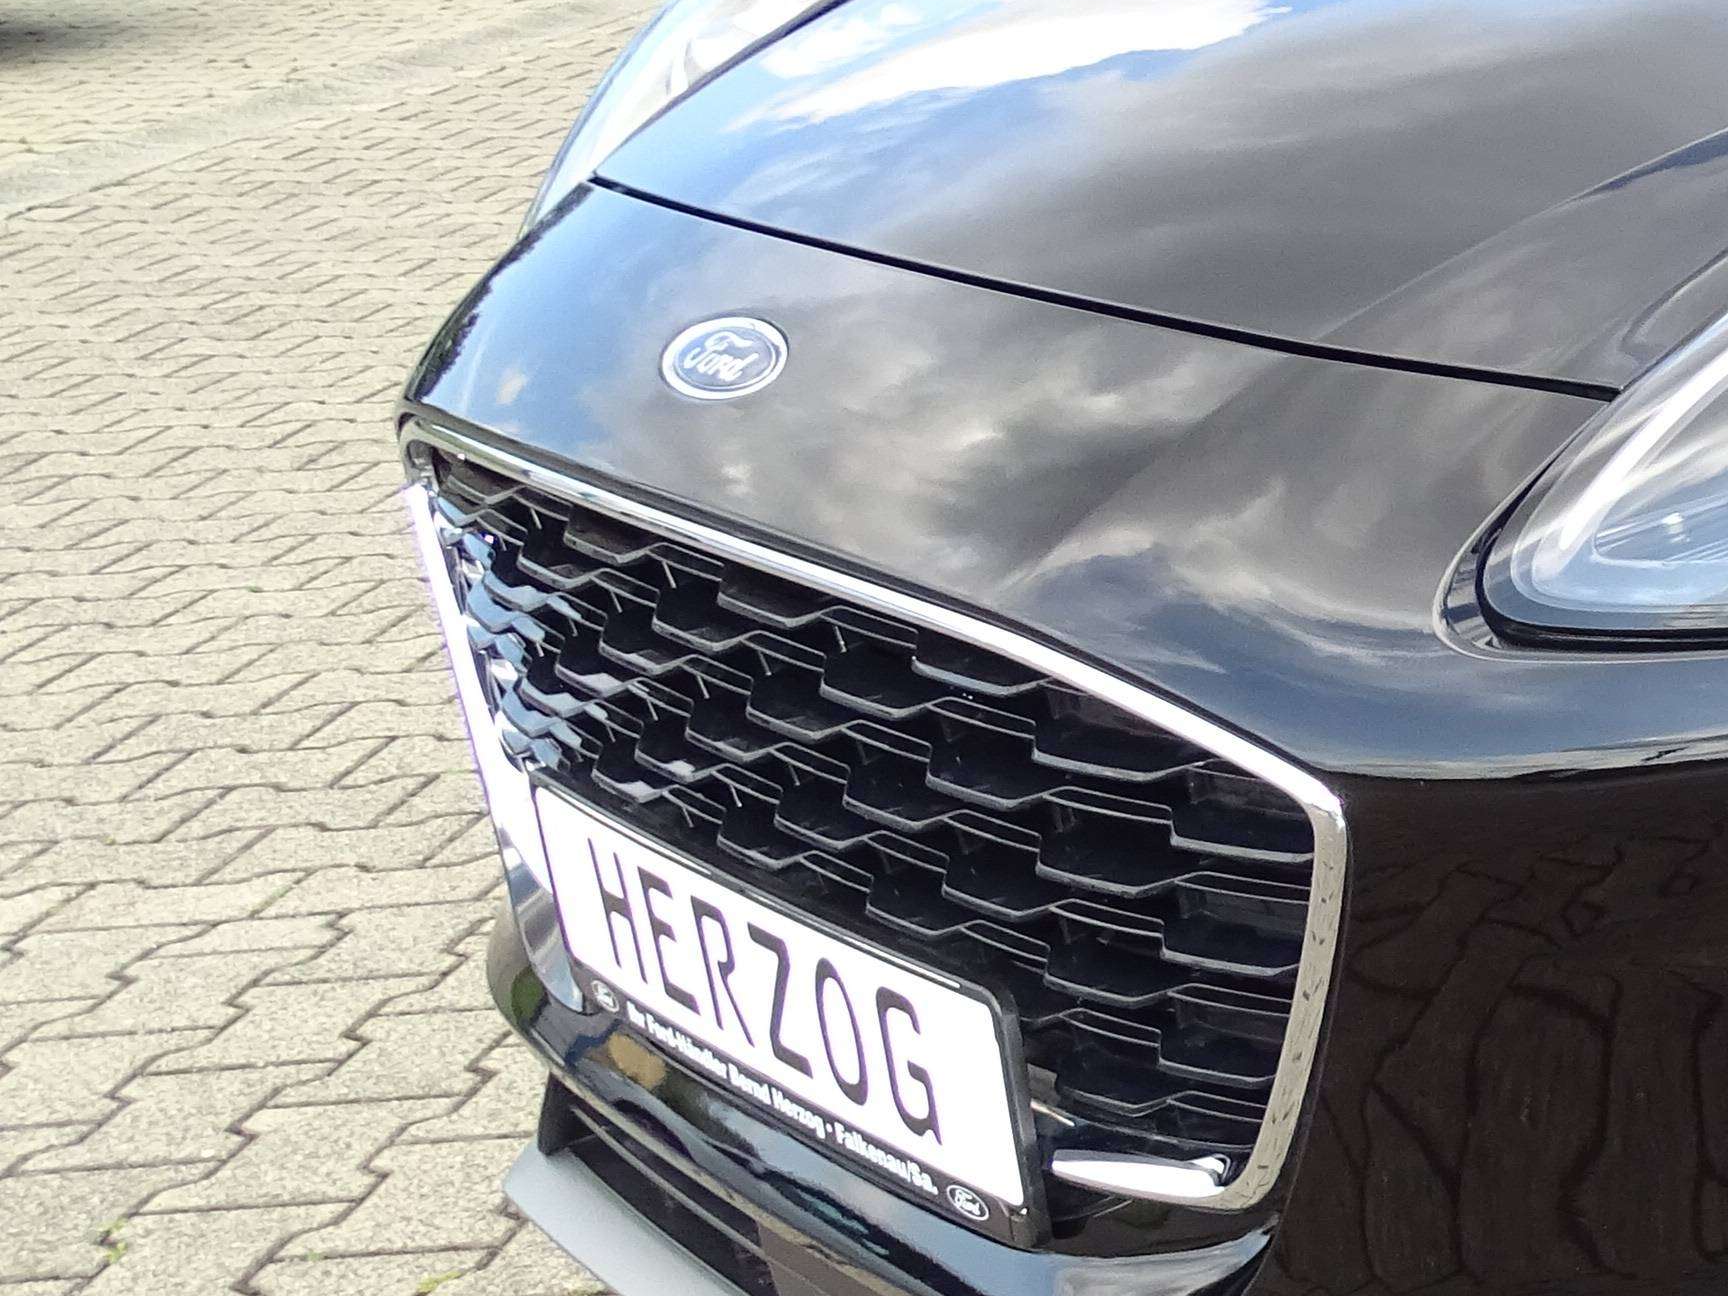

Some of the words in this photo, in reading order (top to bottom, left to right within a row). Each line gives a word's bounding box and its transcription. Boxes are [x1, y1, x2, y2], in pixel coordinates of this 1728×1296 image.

[683, 330, 760, 382] Ford
[588, 837, 943, 1145] HERZOG
[772, 1086, 826, 1139] Herzog
[834, 1121, 938, 1195] Falkenau/Sa.
